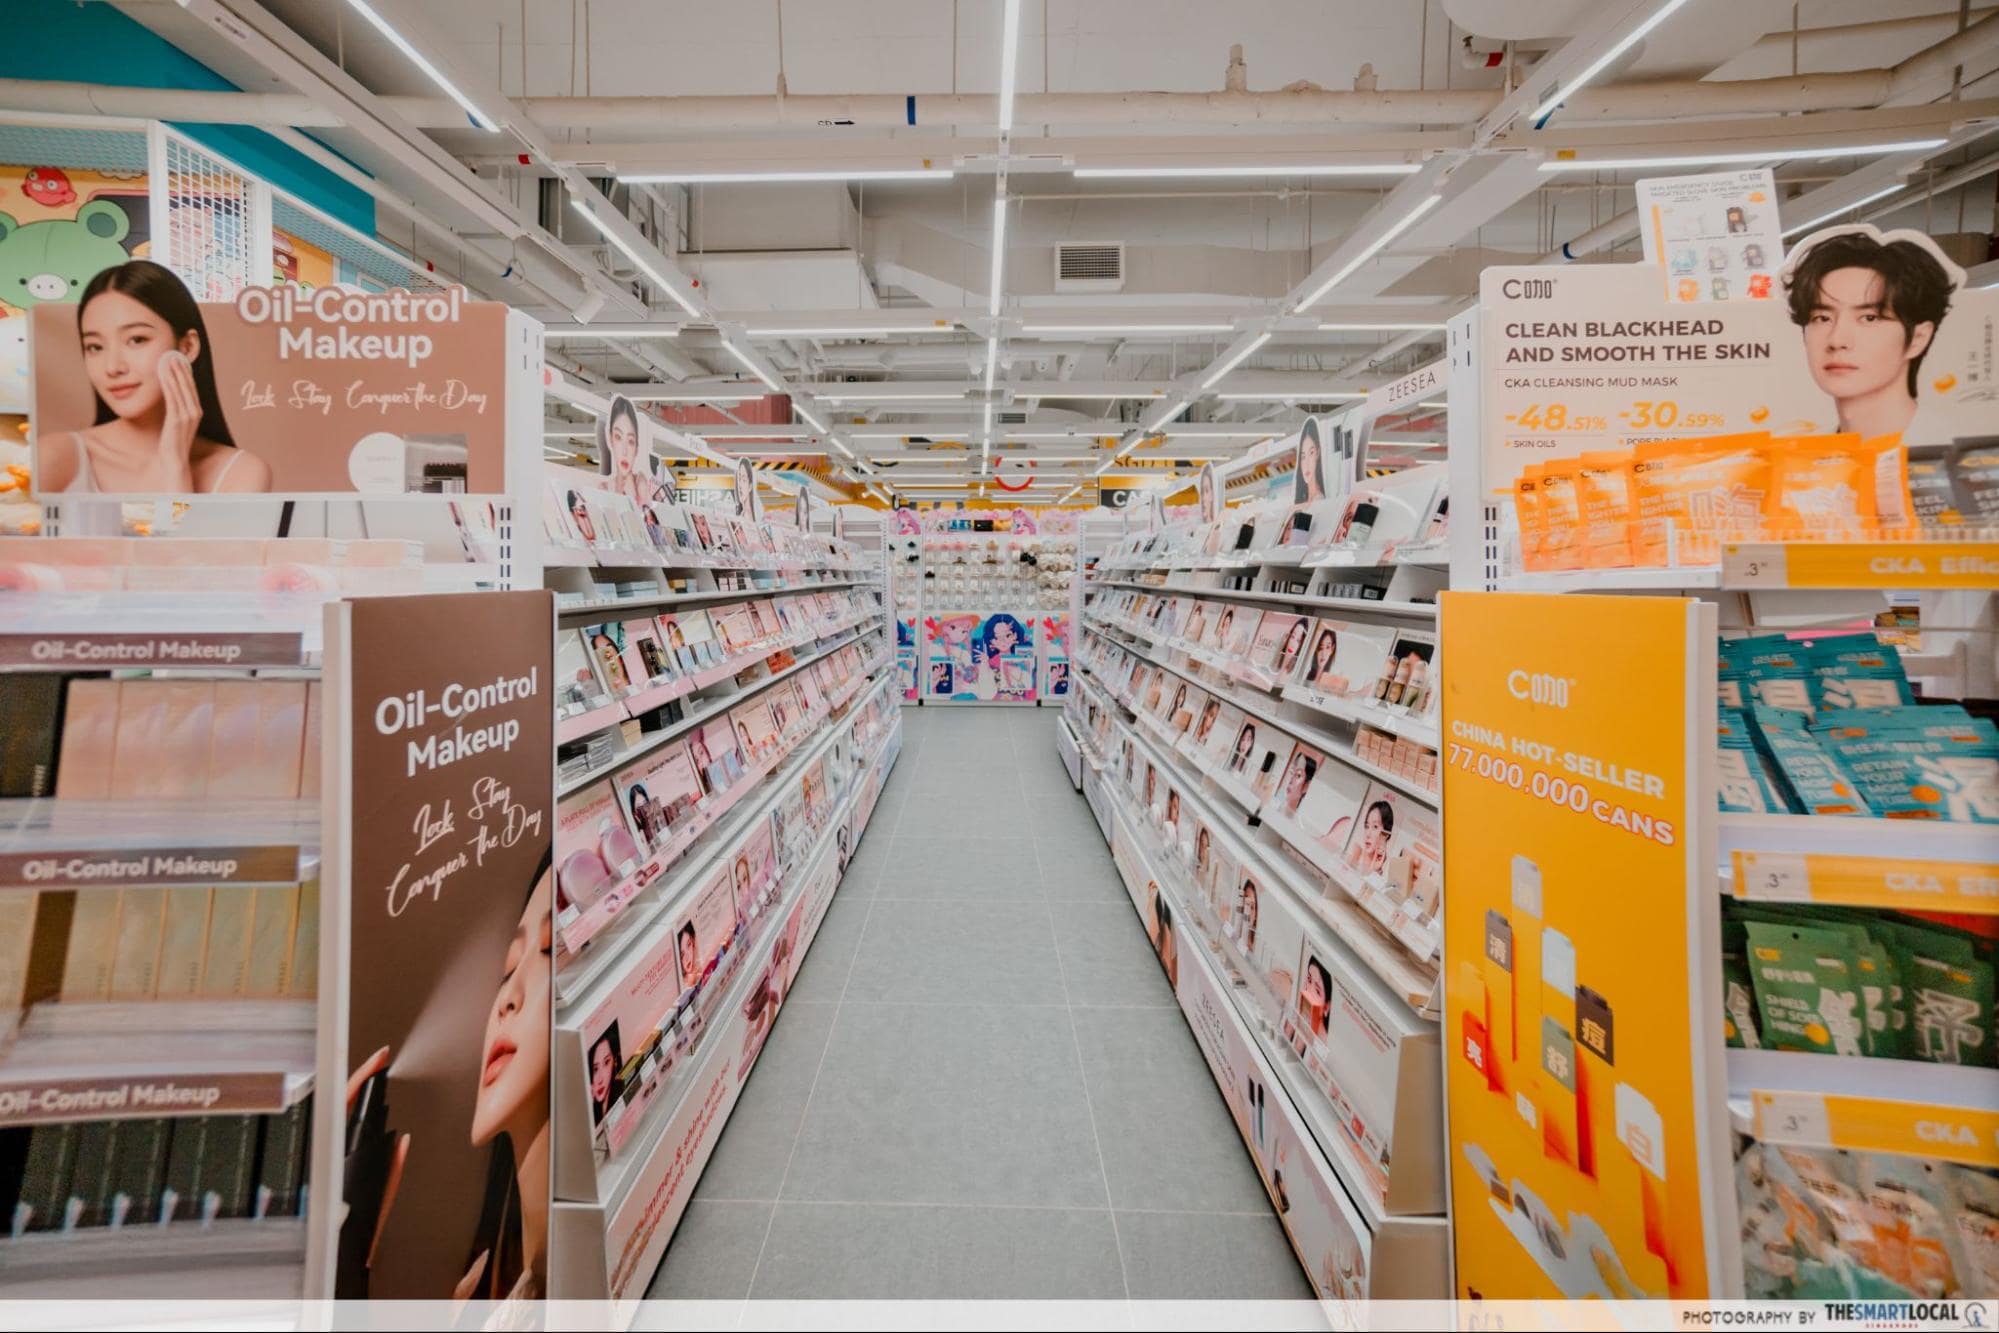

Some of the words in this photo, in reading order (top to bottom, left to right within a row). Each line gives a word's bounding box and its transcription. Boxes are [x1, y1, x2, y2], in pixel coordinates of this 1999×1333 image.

[239, 289, 460, 323] Oil-Control
[1505, 322, 1578, 339] CLEAN
[1585, 320, 1724, 338] BLACKHEAD
[279, 326, 433, 368] Makeup
[1506, 346, 1554, 363] AND
[1561, 345, 1655, 362] SMOOTH
[1662, 344, 1707, 361] THE
[1715, 343, 1771, 360] SKIN
[288, 379, 331, 415] Stay
[440, 379, 488, 414] Day
[1388, 371, 1437, 402] ZEESEA
[1504, 377, 1531, 388] CKA
[1534, 377, 1605, 388] CLEANSING
[1608, 377, 1637, 388] MUD
[1641, 376, 1679, 387] MASK
[1513, 440, 1535, 448] SKIN
[1537, 440, 1556, 448] OILS
[1870, 556, 1926, 574] CKA
[31, 641, 153, 660] Oil-Control
[158, 641, 241, 662] Makeup
[375, 666, 537, 735] Oil-Control
[407, 718, 520, 777] Makeup
[1452, 719, 1506, 751] CHINA
[1511, 736, 1665, 800] HOT-SELLER
[467, 776, 511, 820] Stay
[466, 825, 499, 867] the
[501, 803, 542, 849] Day
[1591, 799, 1675, 845] CANS
[22, 856, 149, 881] Oil-Control
[153, 856, 238, 878] Makeup
[385, 851, 468, 917] Conquer
[1885, 872, 1944, 894] CKA
[131, 1085, 220, 1109] Makeup
[1915, 1120, 1979, 1146] CKA
